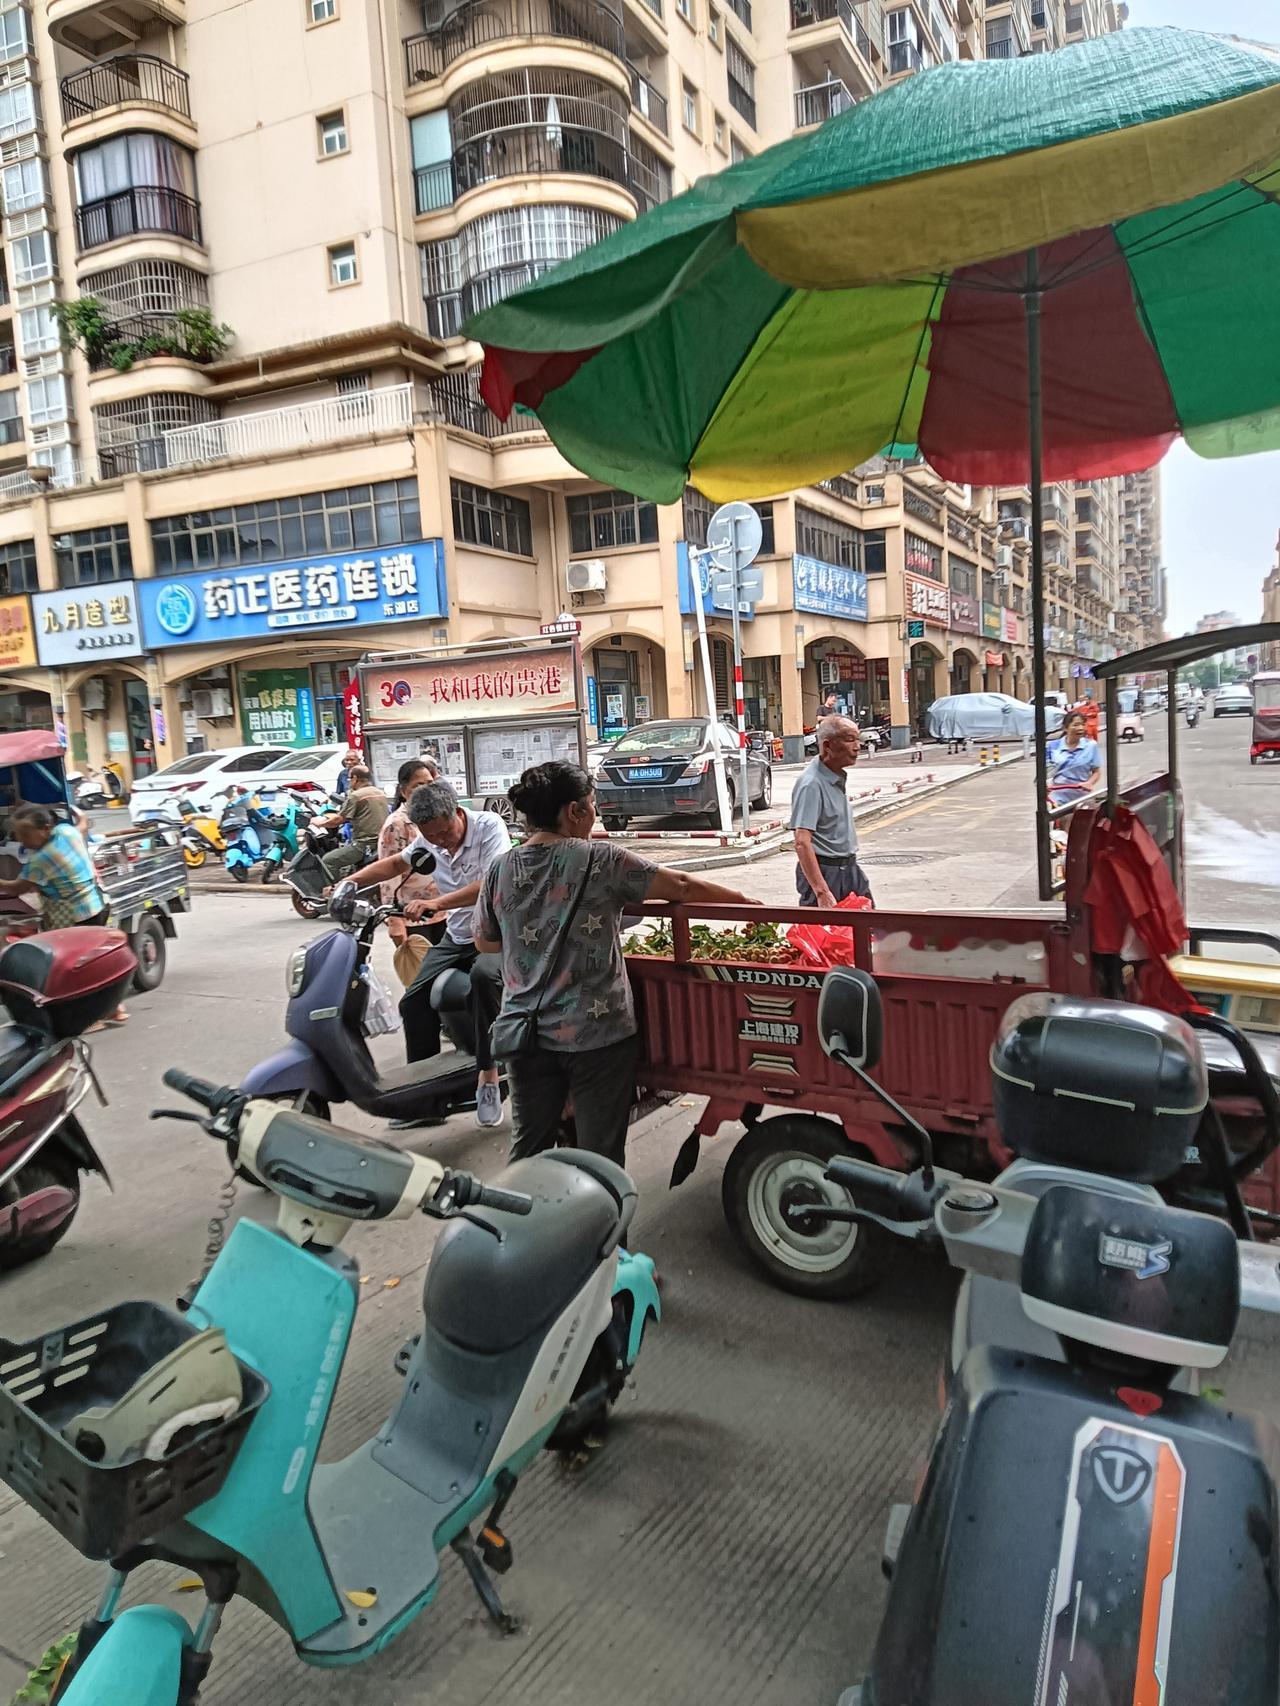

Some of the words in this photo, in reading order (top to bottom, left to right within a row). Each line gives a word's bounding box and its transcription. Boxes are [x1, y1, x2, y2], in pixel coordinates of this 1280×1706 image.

[202, 553, 419, 619] 药正医药连锁
[43, 596, 131, 634] 九月造型
[430, 666, 561, 705] 我和我的贵港
